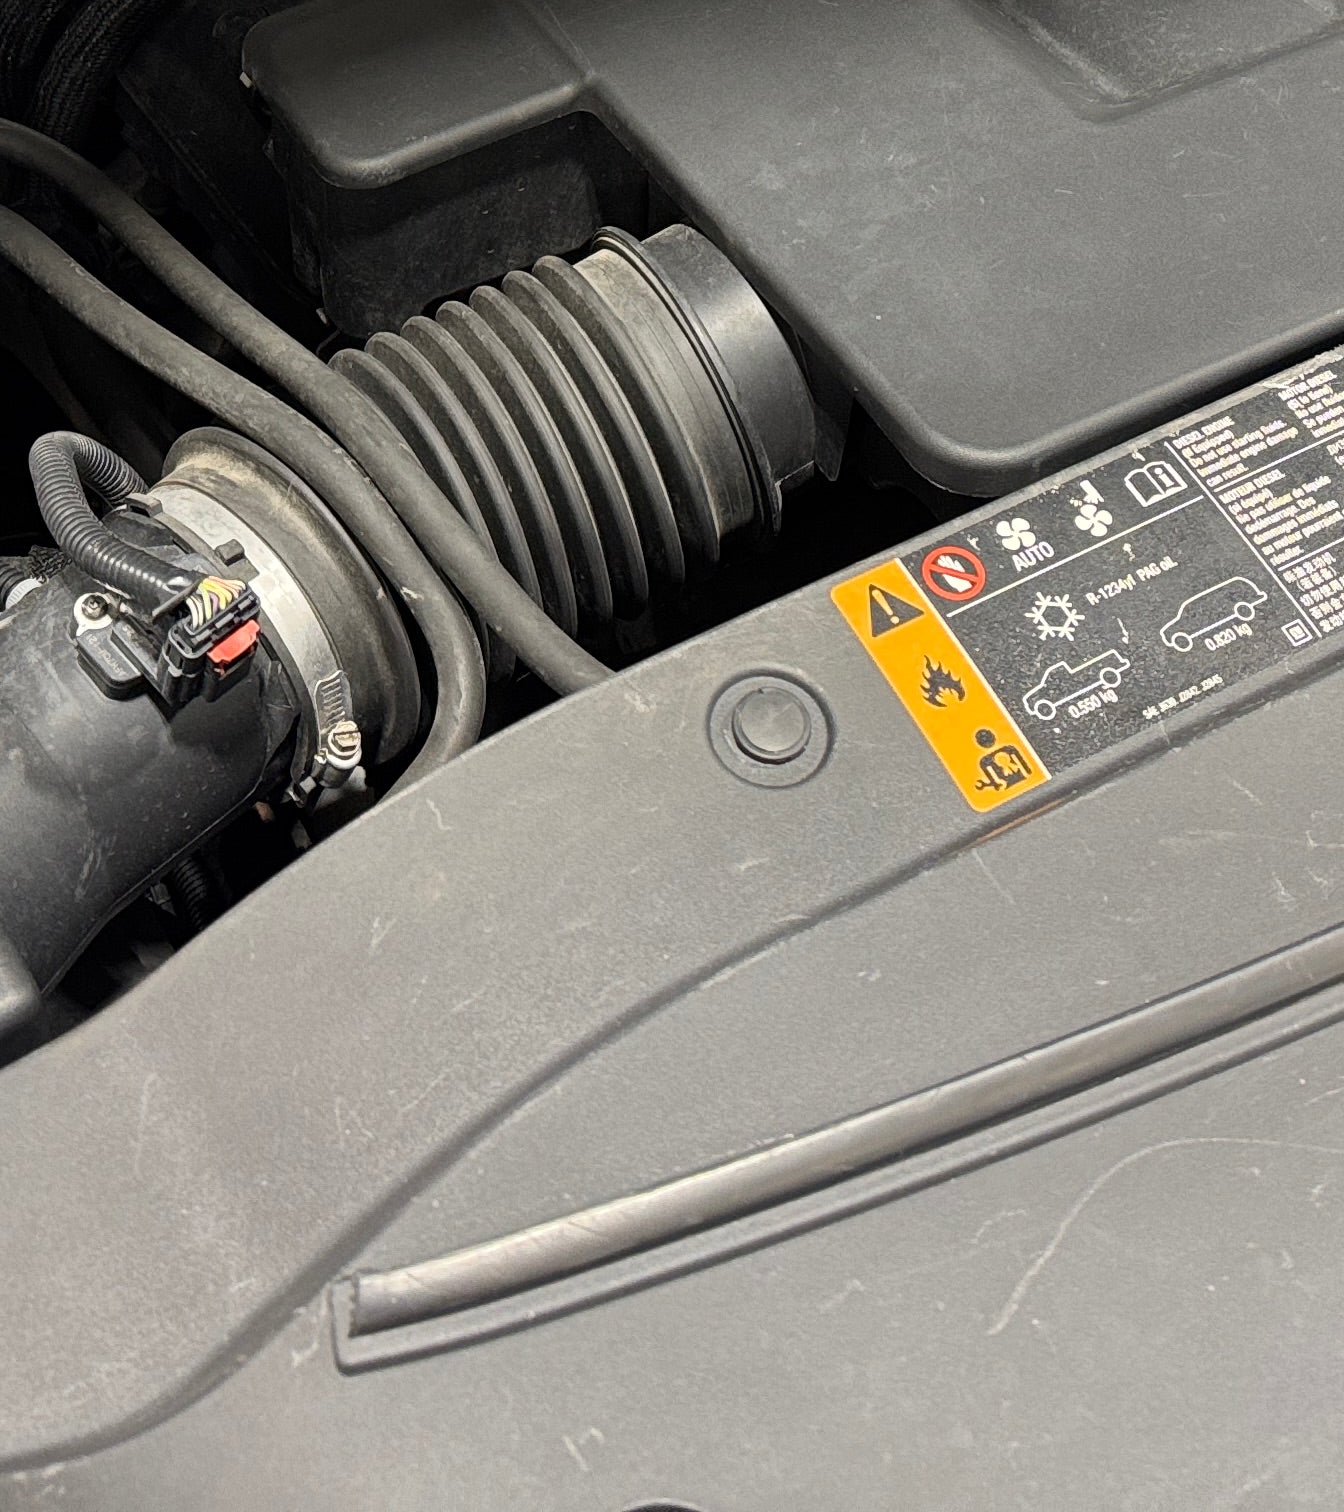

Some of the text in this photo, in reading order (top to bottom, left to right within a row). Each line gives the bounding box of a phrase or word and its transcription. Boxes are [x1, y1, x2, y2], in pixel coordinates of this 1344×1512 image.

[1277, 369, 1338, 401] MOTOR DIESEL
[1171, 415, 1235, 449] DIESEL ENGINE
[1301, 417, 1317, 429] Se
[1188, 456, 1204, 468] Do
[1201, 449, 1218, 462] not
[1215, 443, 1233, 456] use
[1230, 429, 1265, 449] starting
[1196, 426, 1299, 477] Immediate engine damage
[1205, 461, 1249, 487] can result.
[1218, 468, 1286, 504] MOTEUR DIESEL
[1248, 505, 1267, 520] pas
[1291, 486, 1305, 499] de
[1252, 518, 1299, 545] dommages
[1260, 544, 1275, 555] au
[1272, 529, 1303, 550] moteur
[1011, 540, 1055, 572] AUTO
[1084, 573, 1137, 605] R-1234yf
[1135, 562, 1162, 581] PAG
[1203, 622, 1253, 651] 0.820 kg
[1067, 686, 1119, 719] 0.550 kg
